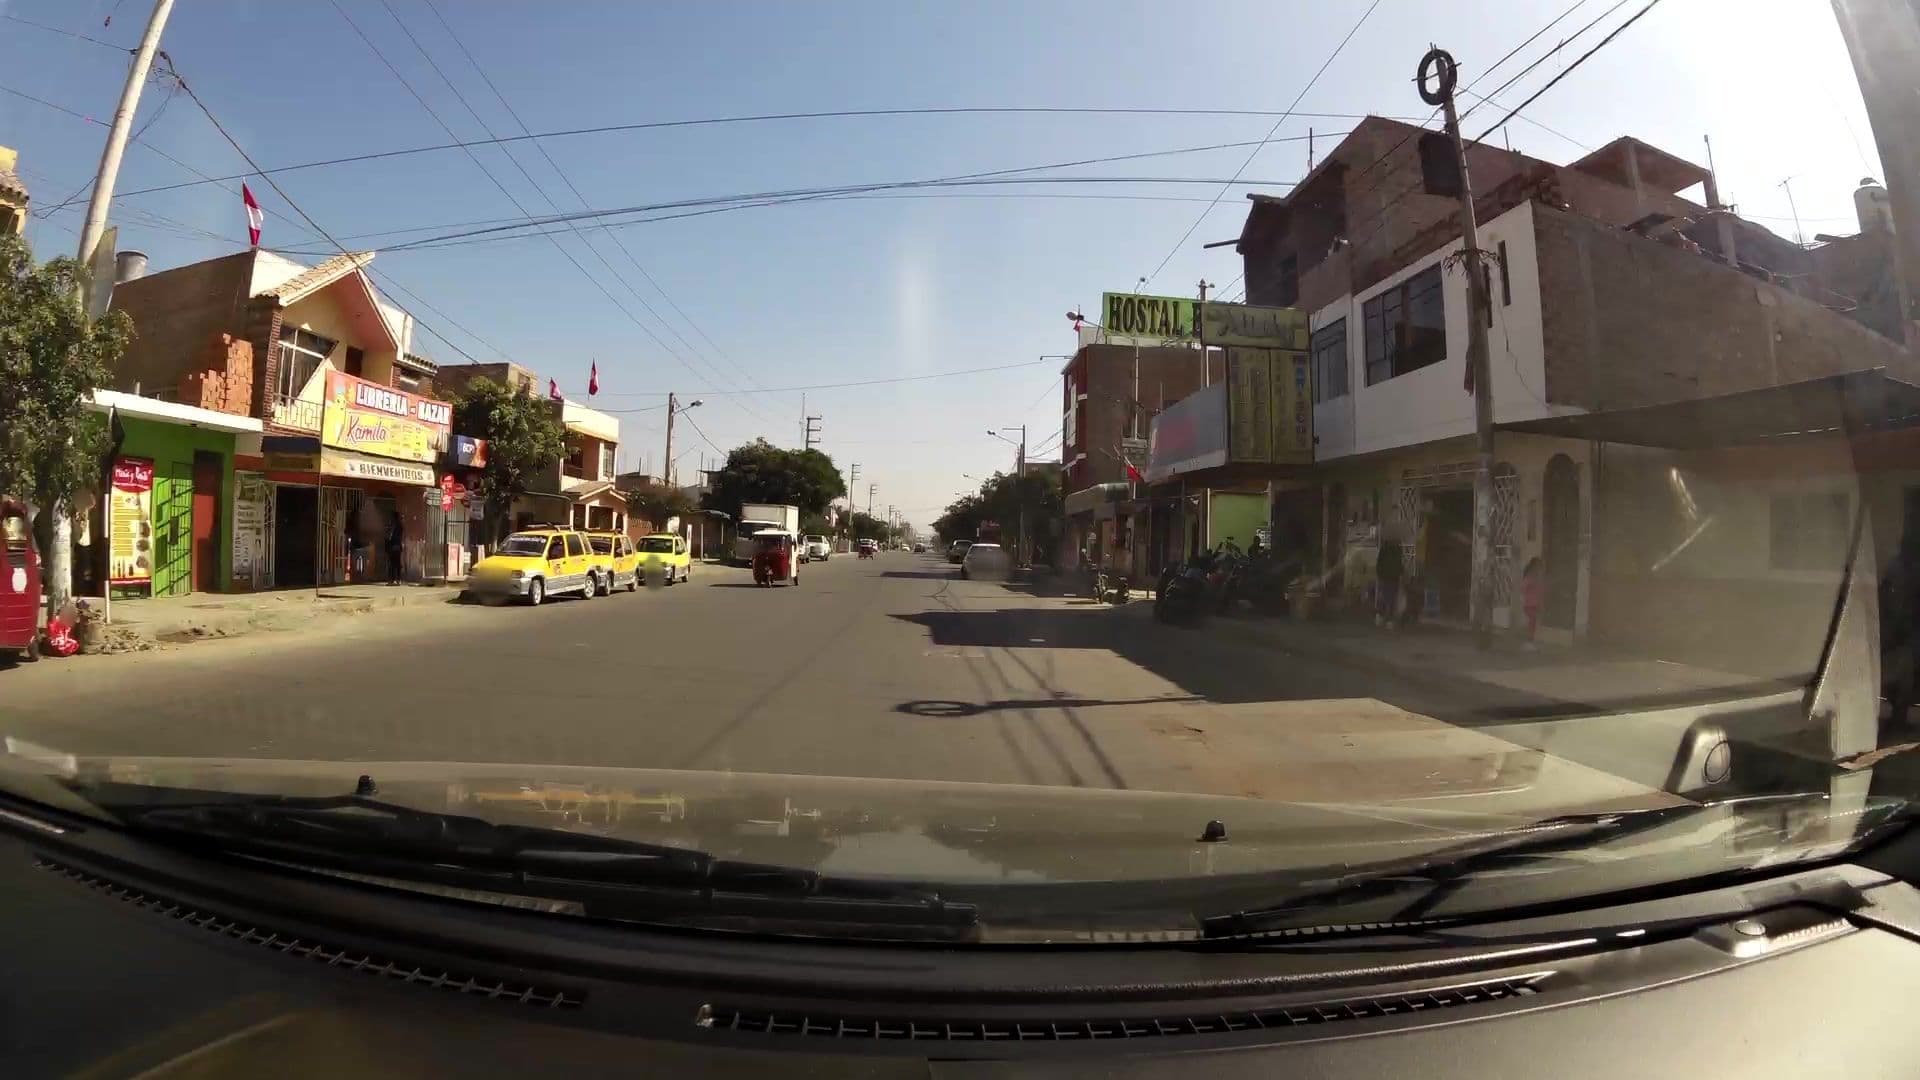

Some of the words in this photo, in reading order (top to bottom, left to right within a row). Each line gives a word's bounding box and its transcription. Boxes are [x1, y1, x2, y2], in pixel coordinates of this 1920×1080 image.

[1108, 295, 1185, 337] HOSTAL
[356, 383, 408, 416] LIBRERIA
[346, 414, 387, 443] Kamila
[359, 463, 424, 481] BIENVENIDOS
